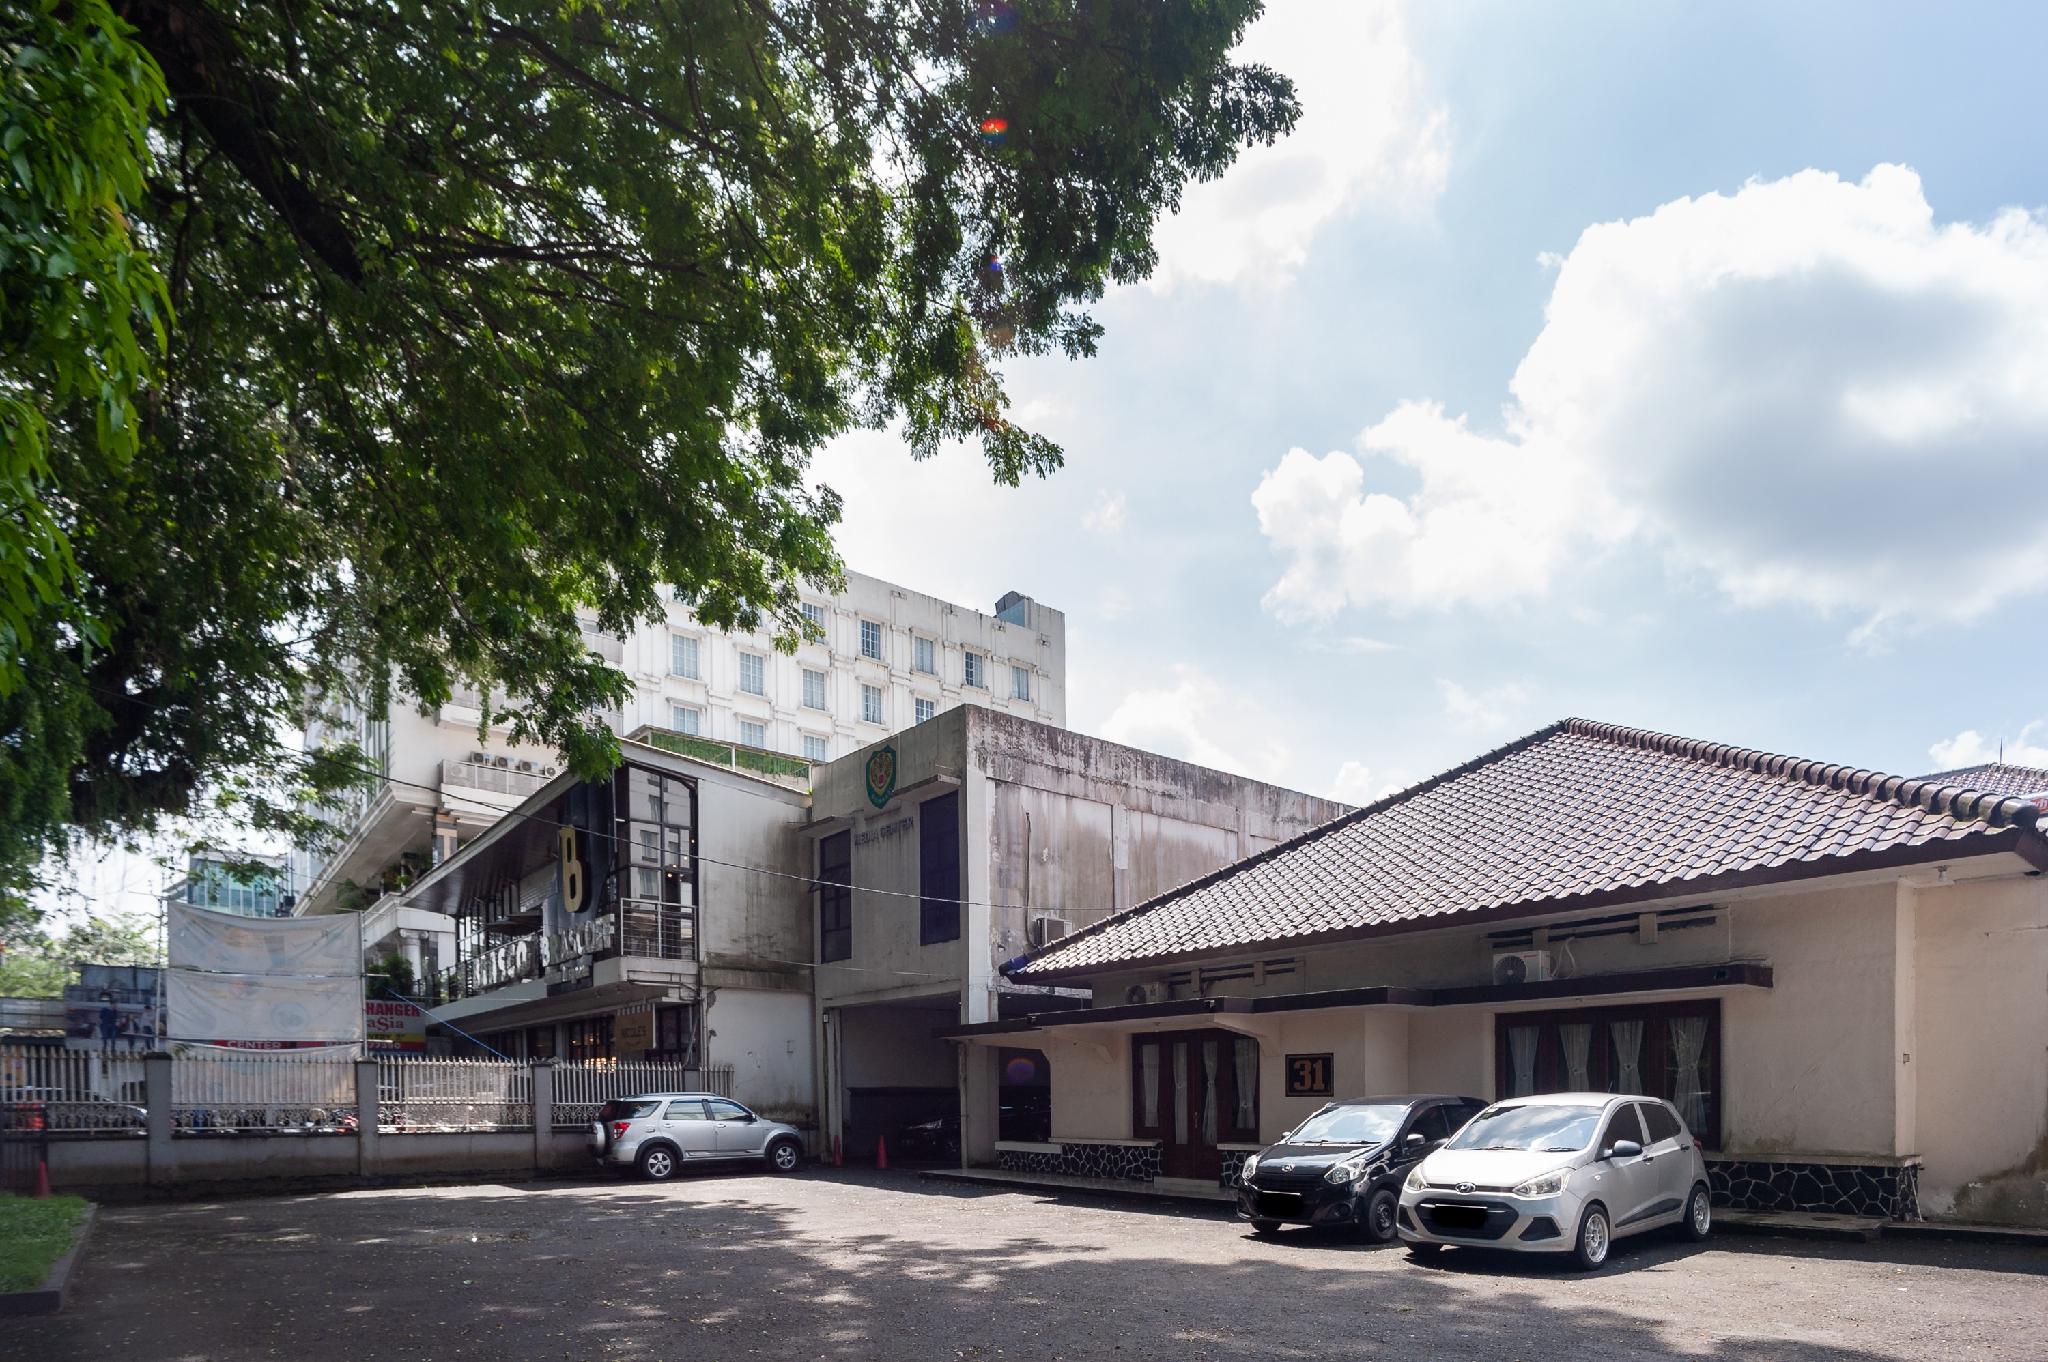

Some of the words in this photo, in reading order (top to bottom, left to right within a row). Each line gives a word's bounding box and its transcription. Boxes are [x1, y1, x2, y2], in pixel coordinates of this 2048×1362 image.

[880, 816, 914, 839] CENTER
[366, 1002, 421, 1017] HANGER
[1294, 1059, 1325, 1090] 31
